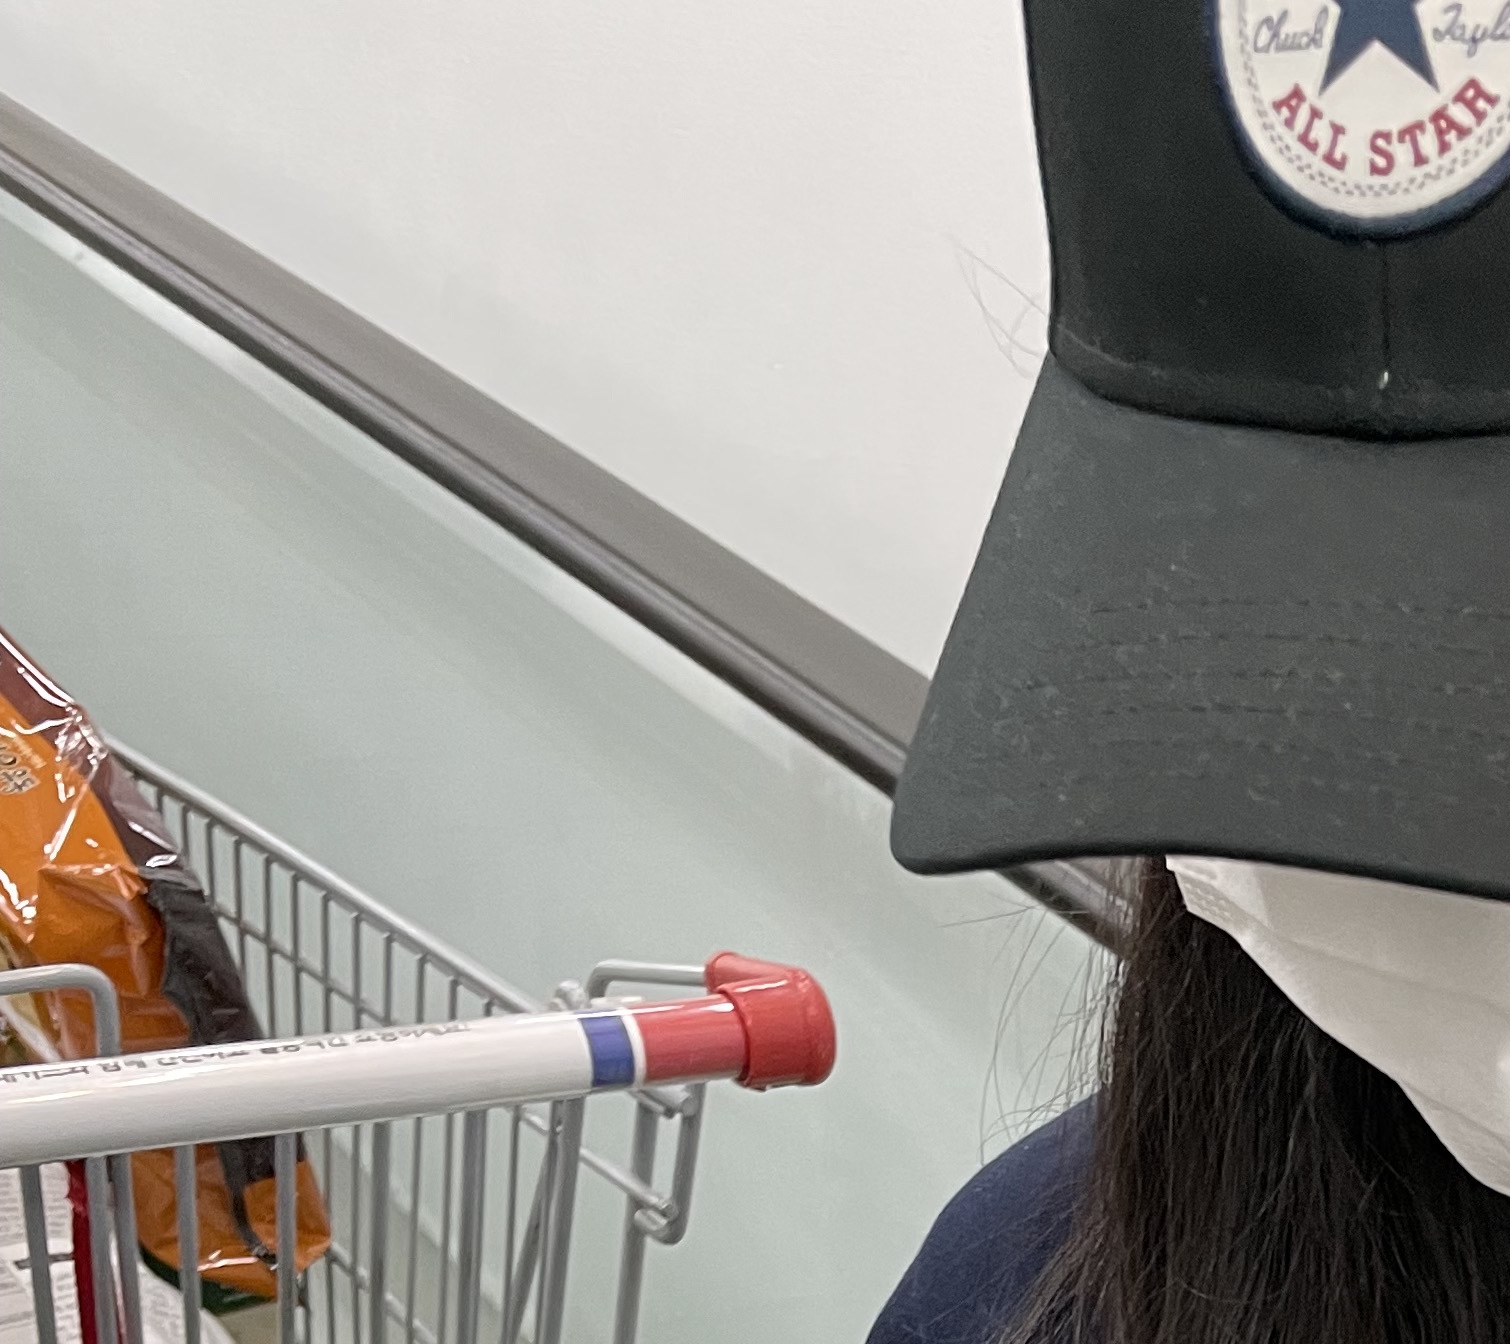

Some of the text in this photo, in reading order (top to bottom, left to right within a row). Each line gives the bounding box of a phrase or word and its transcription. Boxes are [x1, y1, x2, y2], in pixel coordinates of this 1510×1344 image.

[1254, 8, 1329, 54] Chuck
[1272, 76, 1501, 177] ALL STAR
